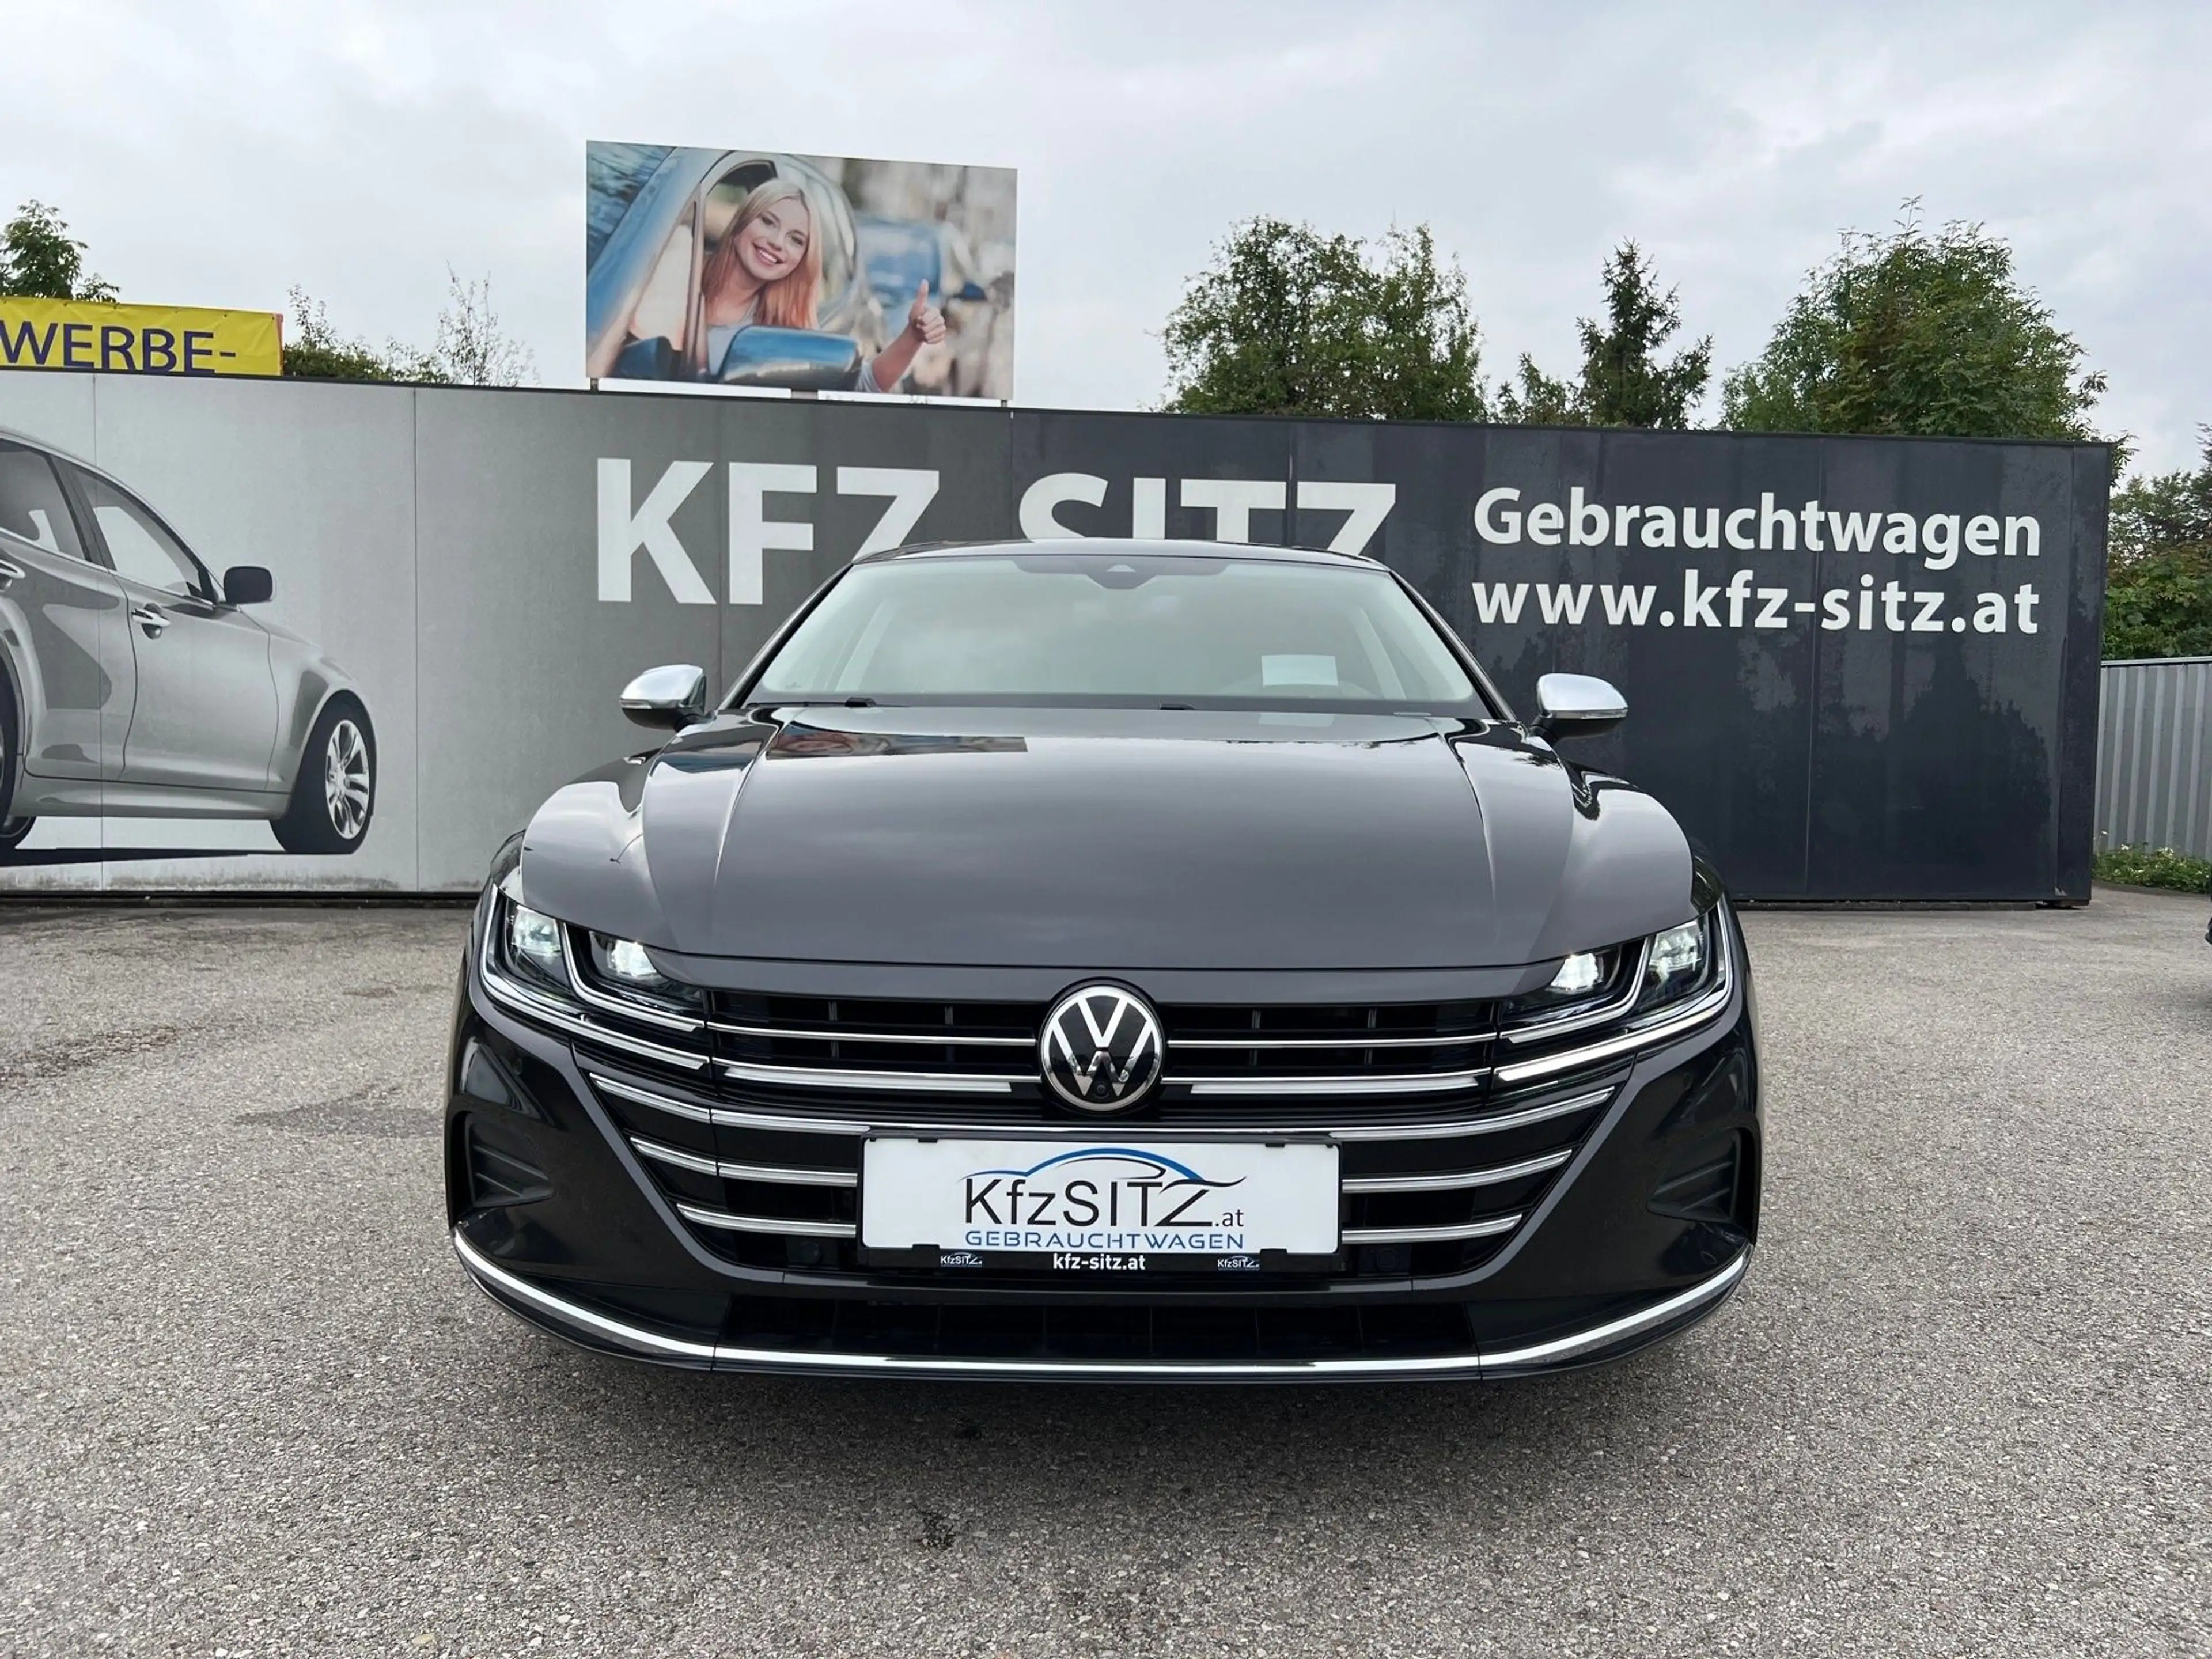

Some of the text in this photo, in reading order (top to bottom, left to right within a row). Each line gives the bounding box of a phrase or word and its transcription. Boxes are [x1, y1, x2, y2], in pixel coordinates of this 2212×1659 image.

[0, 319, 236, 376] WERBE-
[597, 457, 940, 605] KFZ
[1474, 486, 2040, 570] Gebrauchtwagen
[1472, 568, 2039, 634] www.kfz-sitz.at
[965, 1230, 1244, 1249] GEBRAUCHTWAGEN
[1052, 1253, 1146, 1271] kfz-sitz.at
